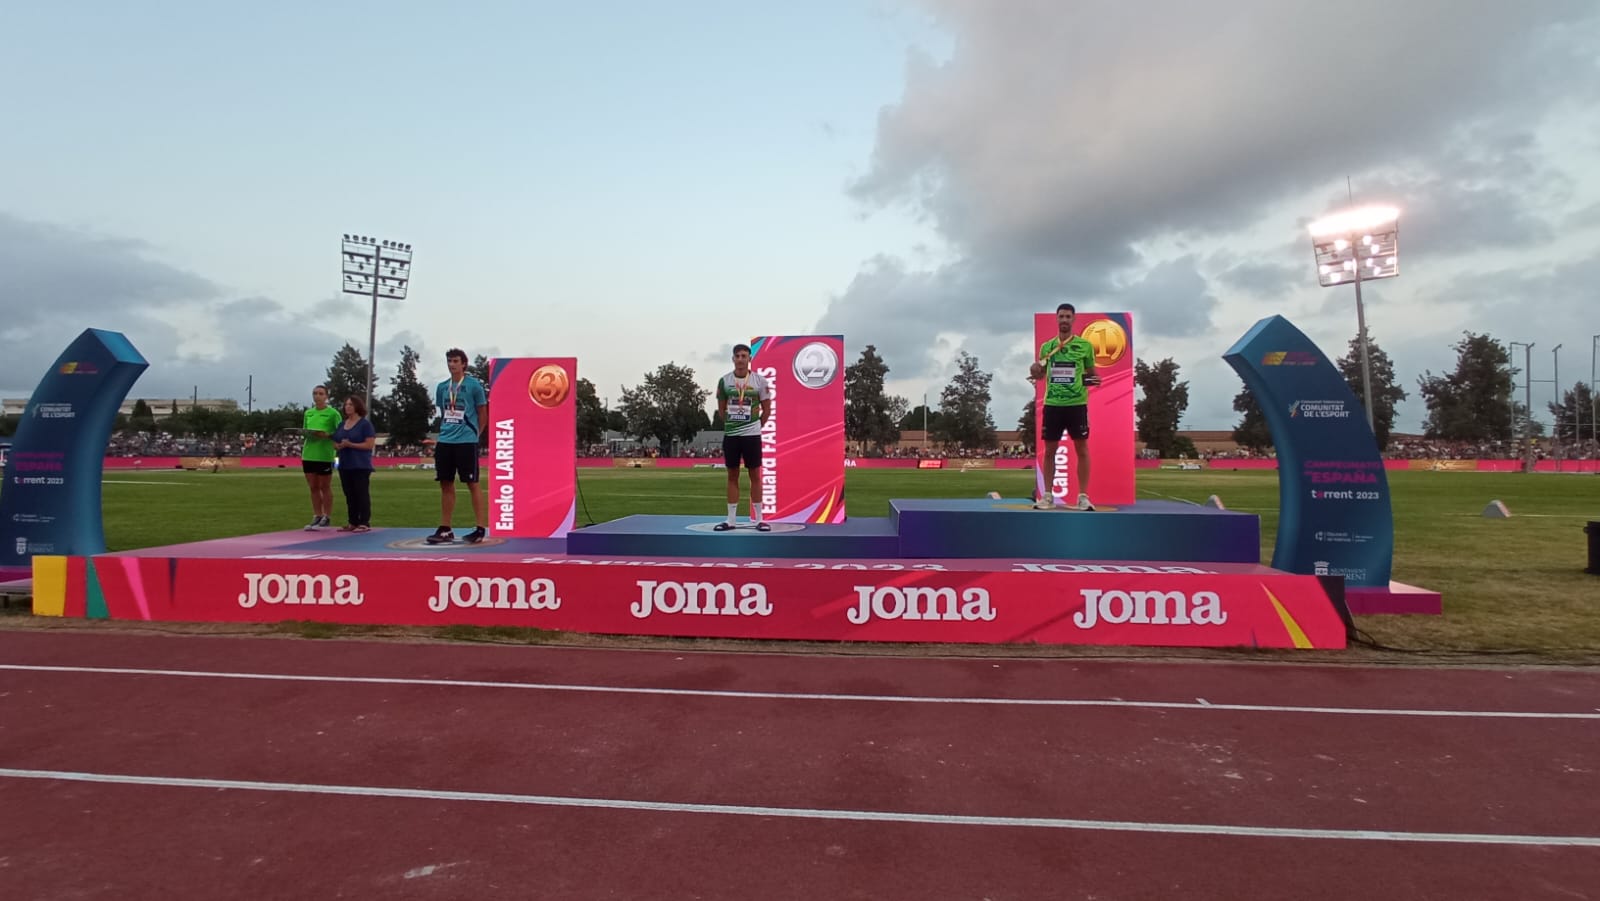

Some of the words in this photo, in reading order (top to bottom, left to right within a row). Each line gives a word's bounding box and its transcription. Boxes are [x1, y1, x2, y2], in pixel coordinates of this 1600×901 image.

[540, 372, 557, 399] 3
[806, 350, 824, 378] 2
[495, 418, 514, 480] LARREA
[1051, 445, 1069, 498] Carlos
[495, 485, 514, 531] Eneko
[761, 456, 777, 514] Eduard
[1311, 489, 1354, 499] torrent
[1355, 490, 1380, 500] 2023
